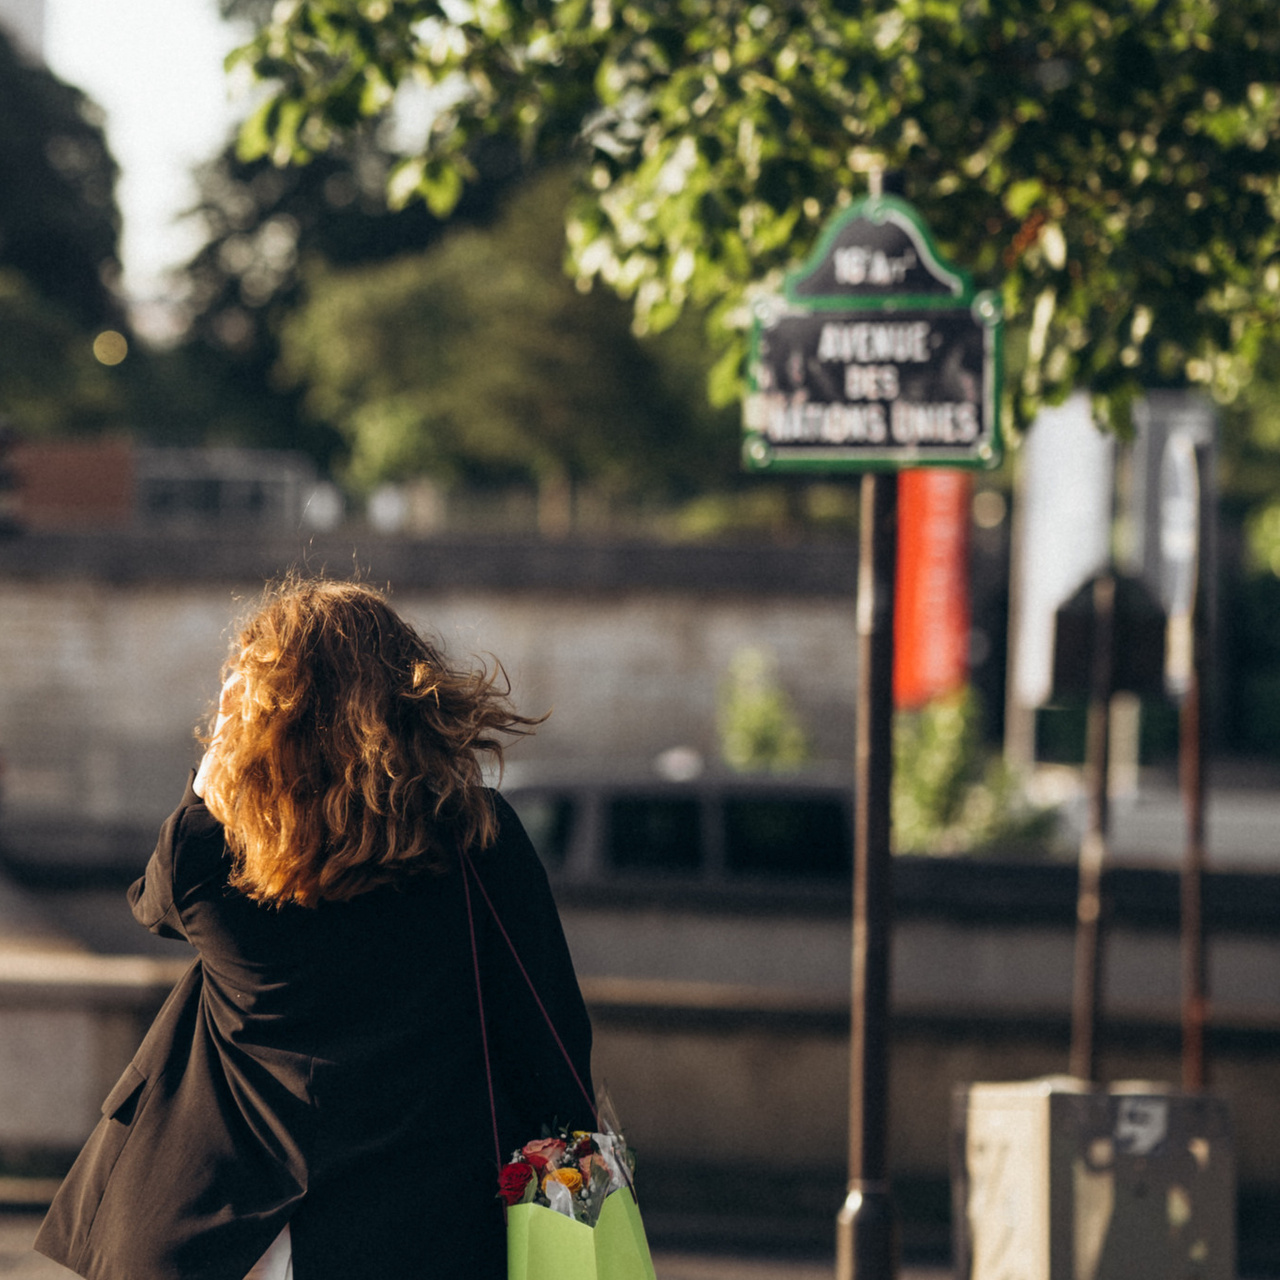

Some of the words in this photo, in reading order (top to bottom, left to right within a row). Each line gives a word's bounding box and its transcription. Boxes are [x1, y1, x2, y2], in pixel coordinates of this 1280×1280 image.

[818, 321, 931, 362] AVENUE
[844, 363, 901, 401] DES
[891, 401, 979, 443] UNIES
